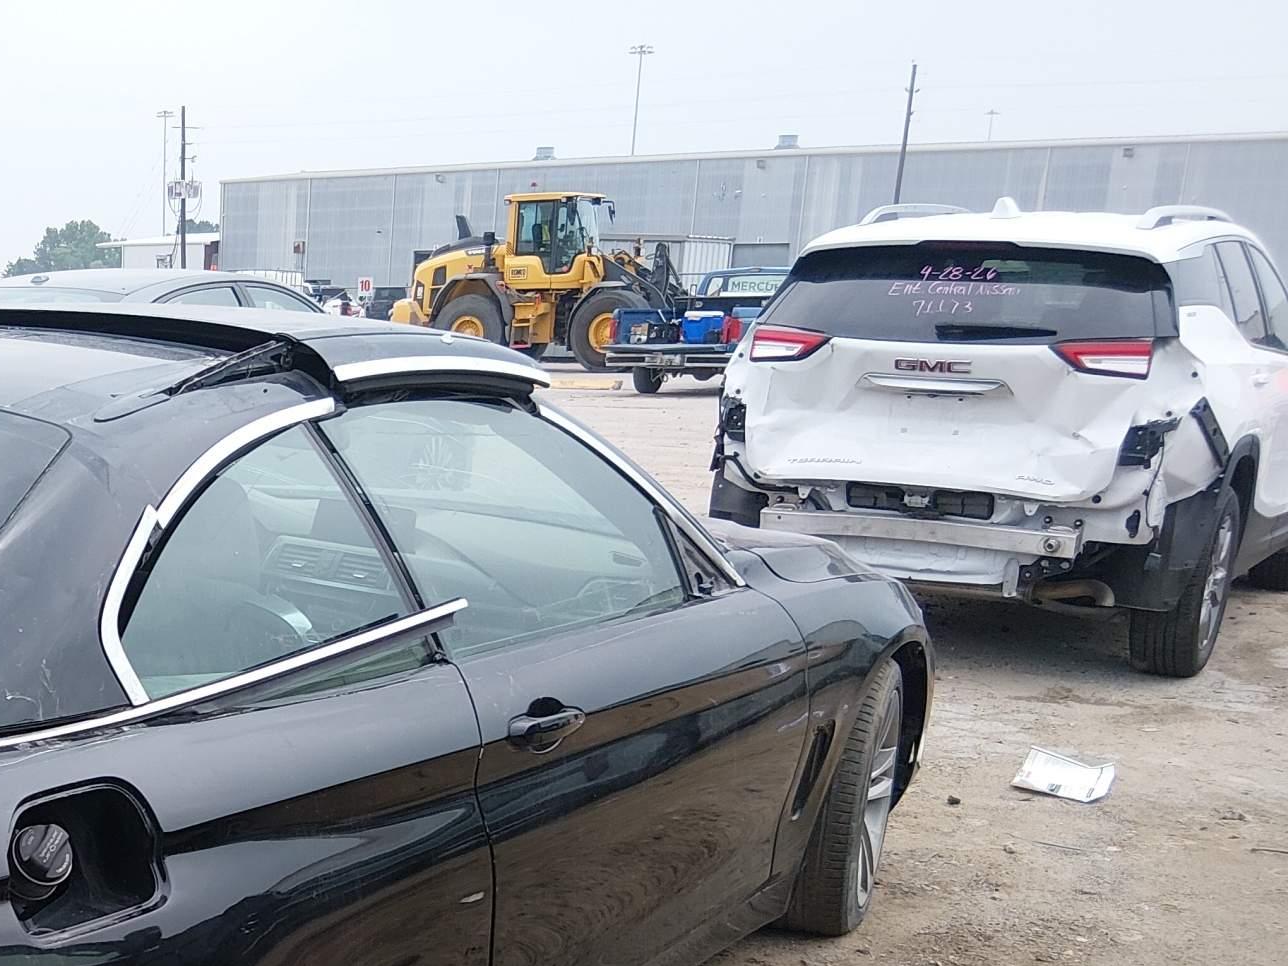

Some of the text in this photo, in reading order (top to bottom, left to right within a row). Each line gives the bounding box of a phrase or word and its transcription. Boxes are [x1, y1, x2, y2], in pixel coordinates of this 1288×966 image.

[919, 265, 999, 281] 4-28-26
[359, 279, 371, 292] 10
[928, 281, 974, 296] Central
[912, 299, 973, 317] 71173
[894, 357, 973, 374] GMC
